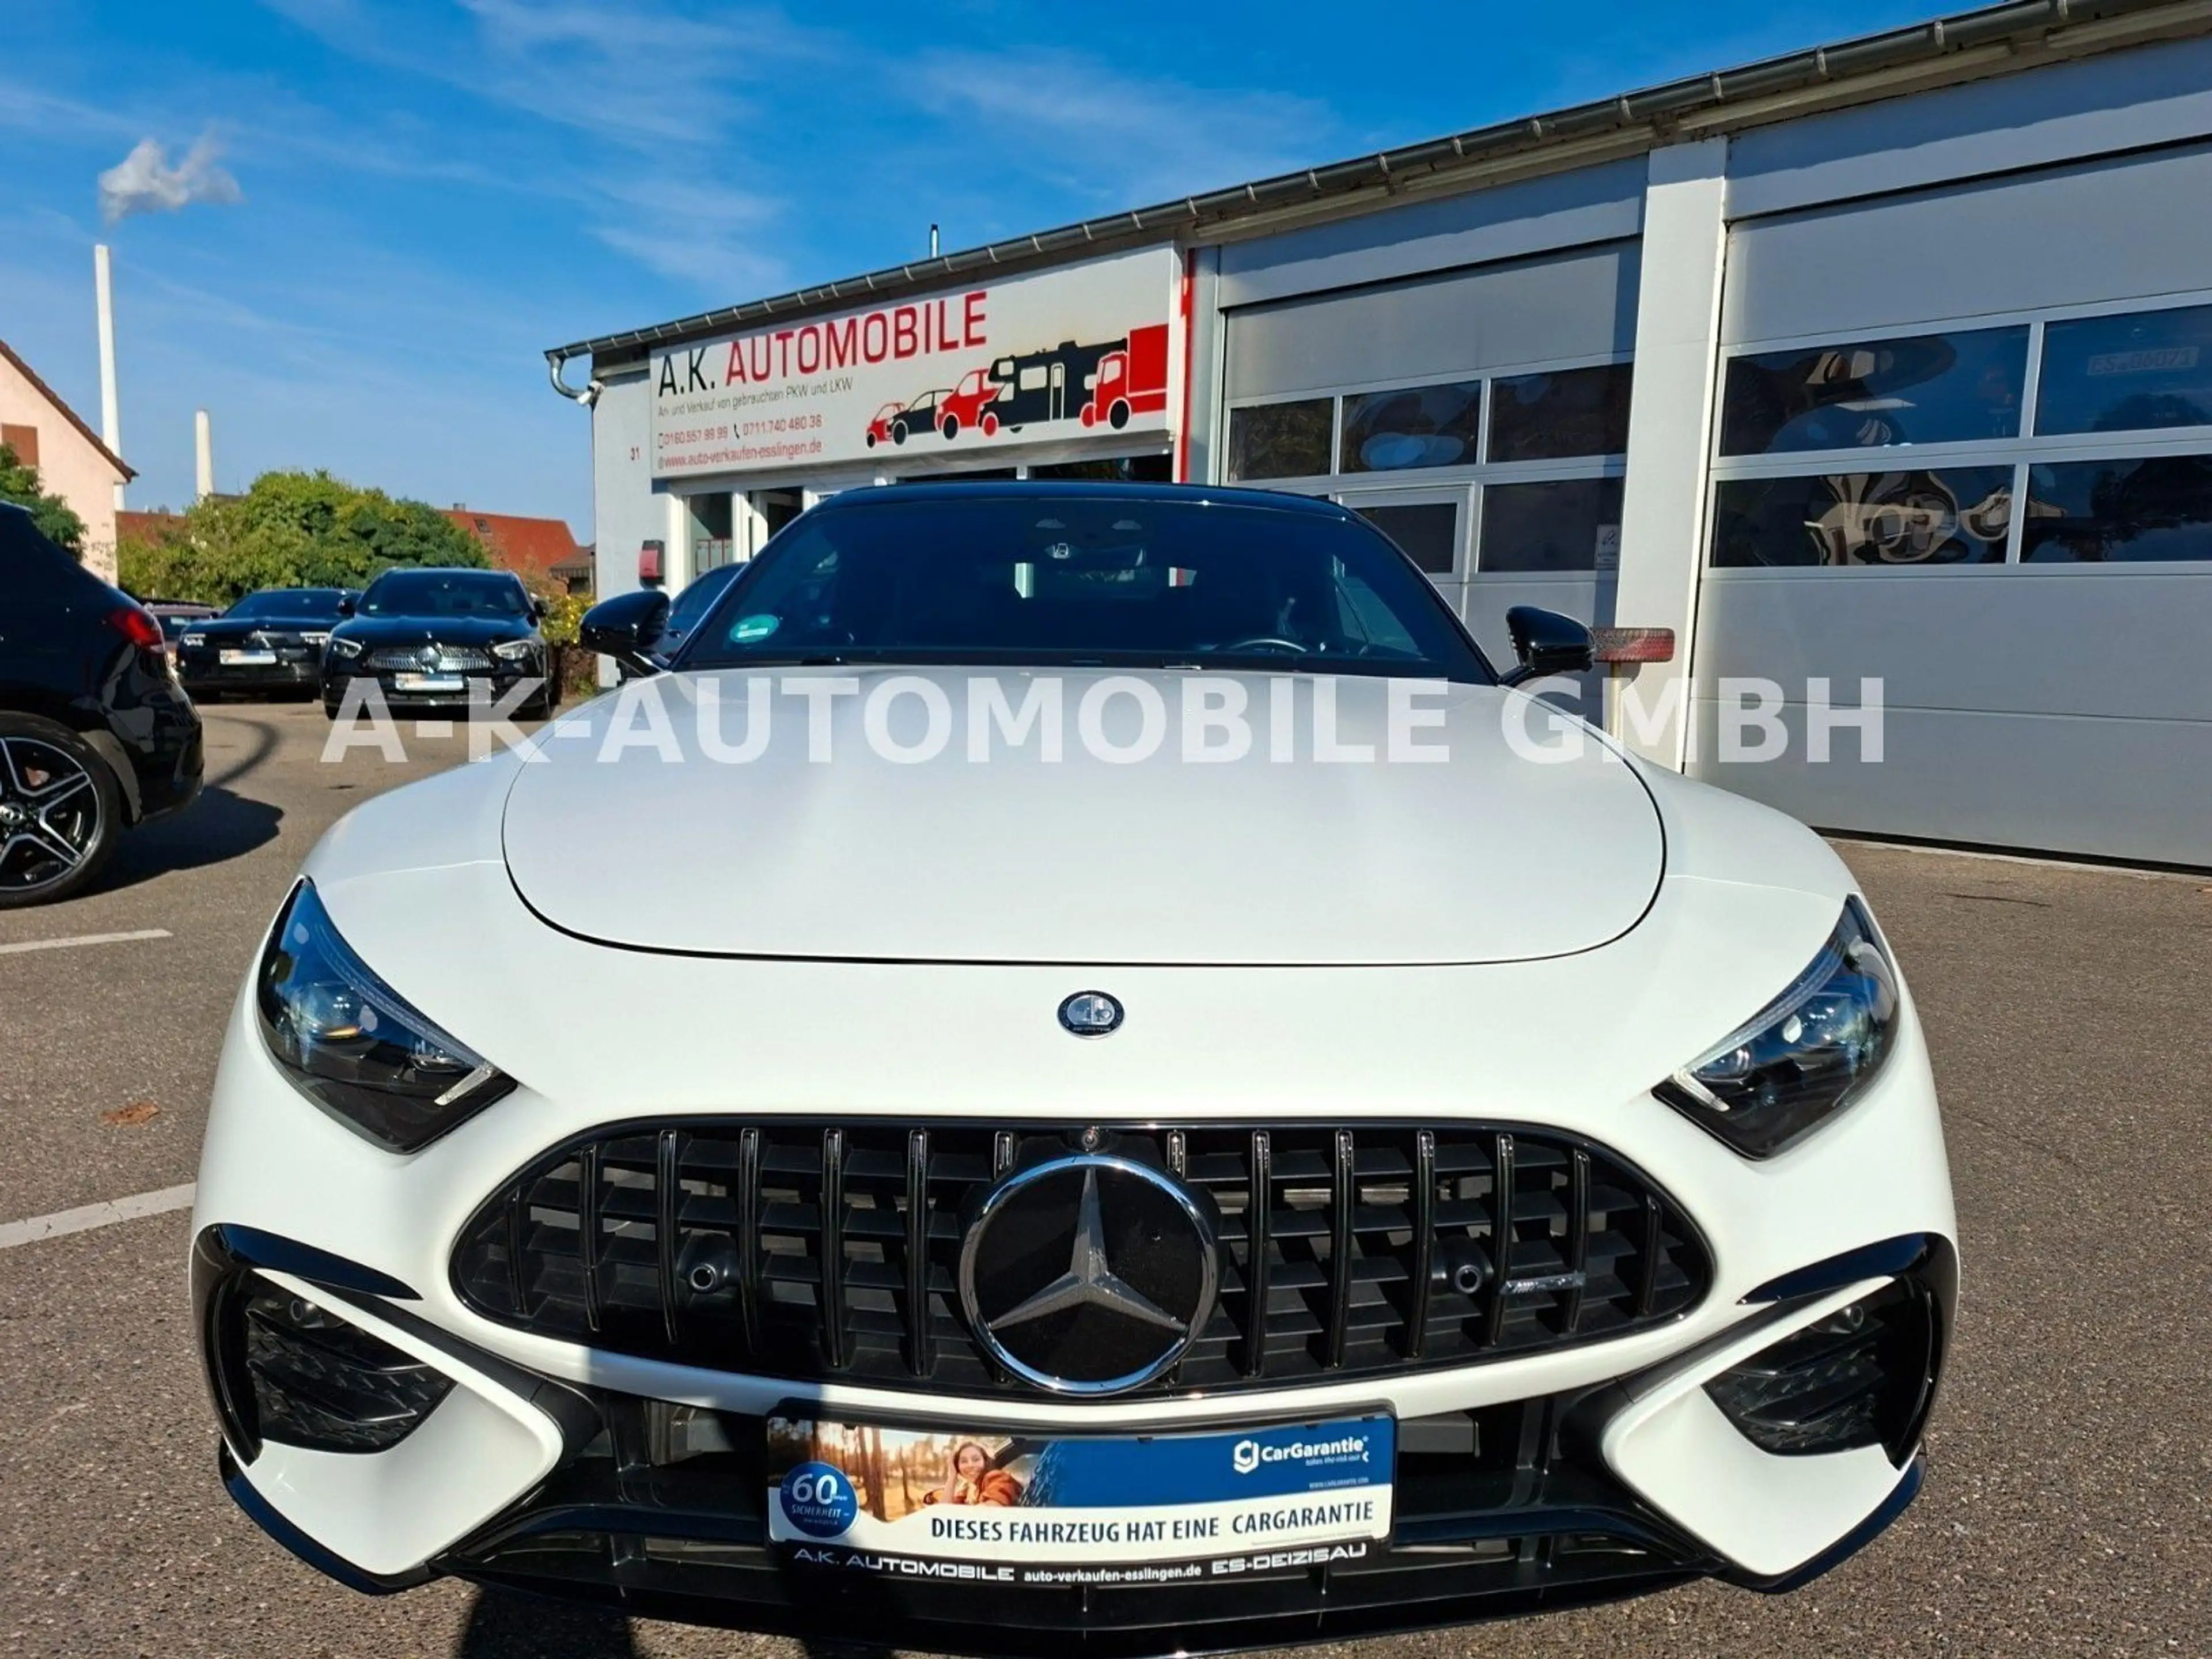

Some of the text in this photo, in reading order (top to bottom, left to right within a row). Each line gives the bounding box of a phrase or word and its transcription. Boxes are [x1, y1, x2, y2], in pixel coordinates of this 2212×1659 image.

[658, 291, 987, 397] A.K. AUTOMOBILE
[785, 384, 808, 399] PKW
[810, 380, 827, 396] und
[829, 377, 853, 393] LKW
[792, 1473, 838, 1505] 60
[931, 1501, 1374, 1543] DIESES FAHRZEUG HAT EINE CARGARANTIE
[794, 1548, 840, 1565] A.K.
[845, 1555, 1015, 1581] AUTOMOBILE
[1024, 1564, 1202, 1583] auto-verkaufen-esslingen.de
